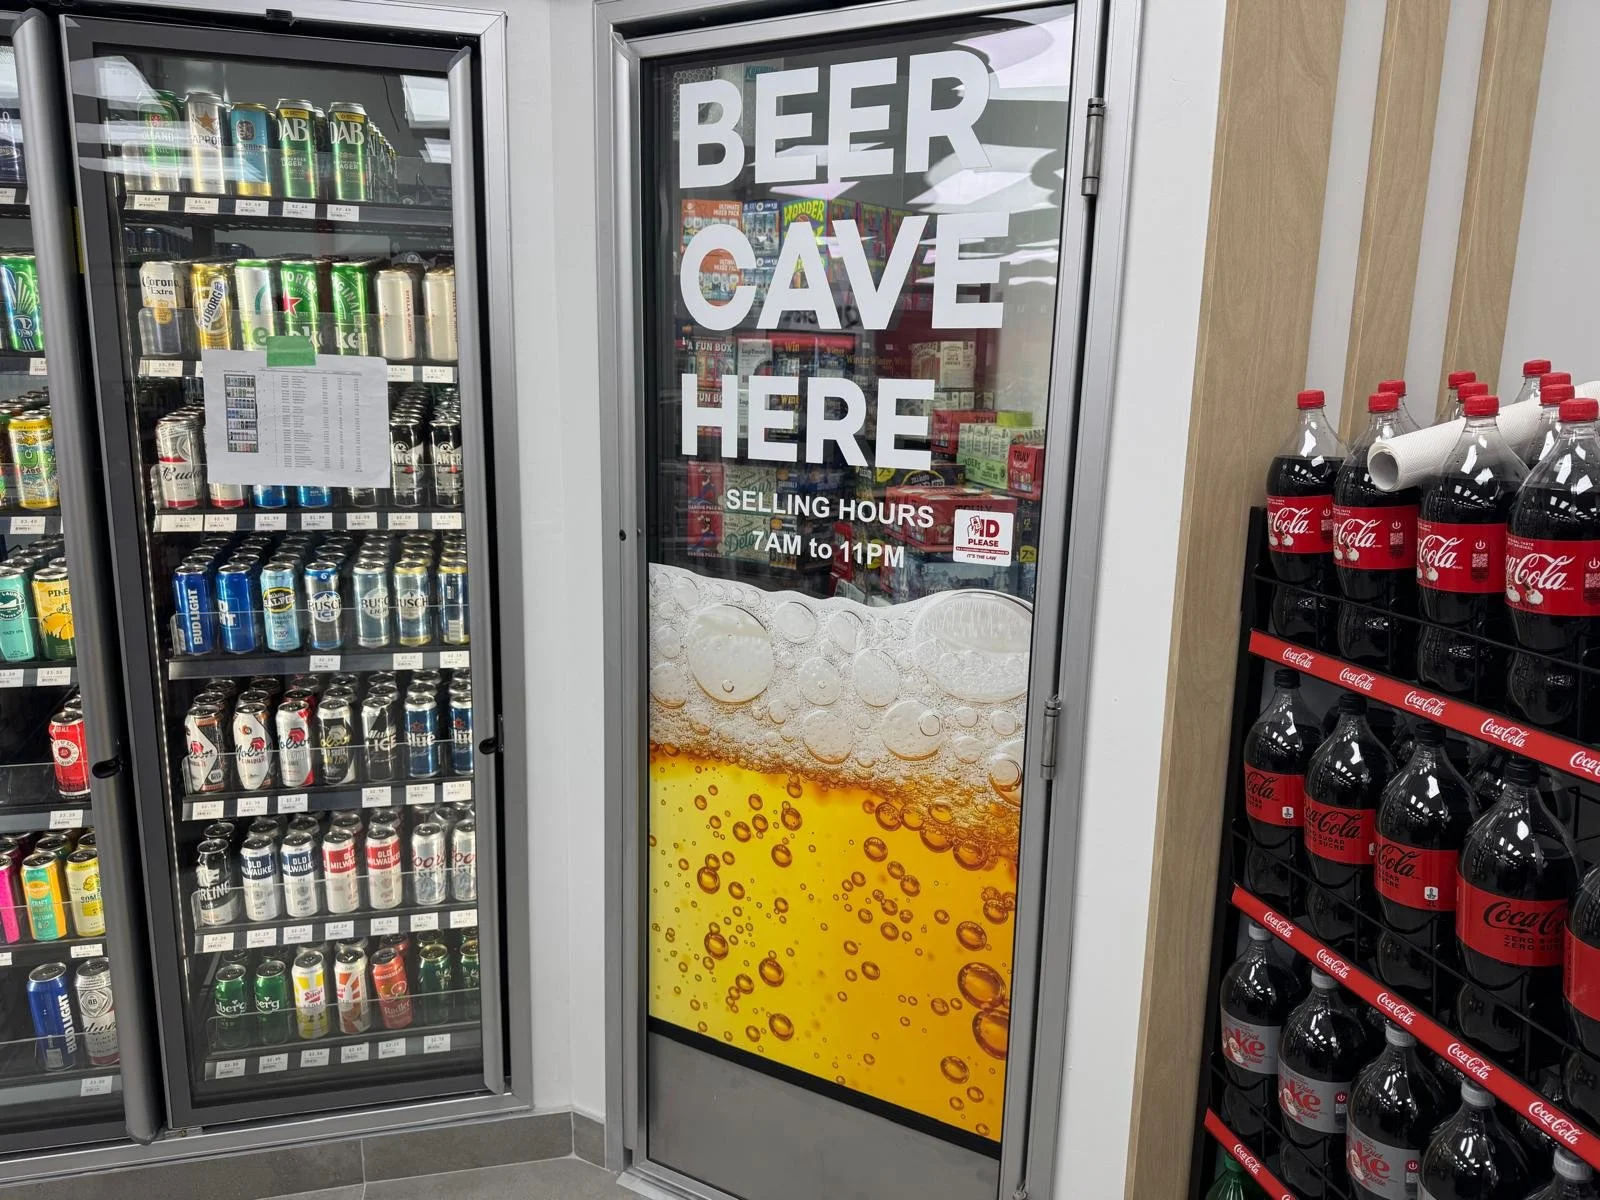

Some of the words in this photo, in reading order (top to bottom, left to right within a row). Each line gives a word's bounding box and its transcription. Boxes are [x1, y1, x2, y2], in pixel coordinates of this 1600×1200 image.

[679, 50, 992, 189] BEER
[783, 199, 825, 226] WONDER
[142, 275, 181, 288] Corona
[680, 212, 1011, 331] CAVE
[150, 286, 174, 296] Extra
[715, 344, 732, 352] BOX
[681, 373, 936, 471] HERE
[726, 488, 831, 518] SELLING
[839, 498, 934, 528] HOURS
[979, 518, 1000, 538] ID
[752, 530, 801, 556] 7AM
[809, 537, 833, 559] to
[839, 540, 905, 569] 11PM
[968, 538, 999, 548] PLEASE
[187, 588, 201, 621] LIGHT
[191, 622, 204, 645] BUD
[373, 734, 397, 751] ICE
[1318, 833, 1345, 845] SUGAR
[1318, 840, 1345, 851] SUCRE
[247, 859, 262, 868] OLD
[292, 856, 307, 864] OLD
[1504, 935, 1535, 945] ZERO
[58, 994, 73, 1028] LIGHT
[65, 1026, 77, 1054] BUD
